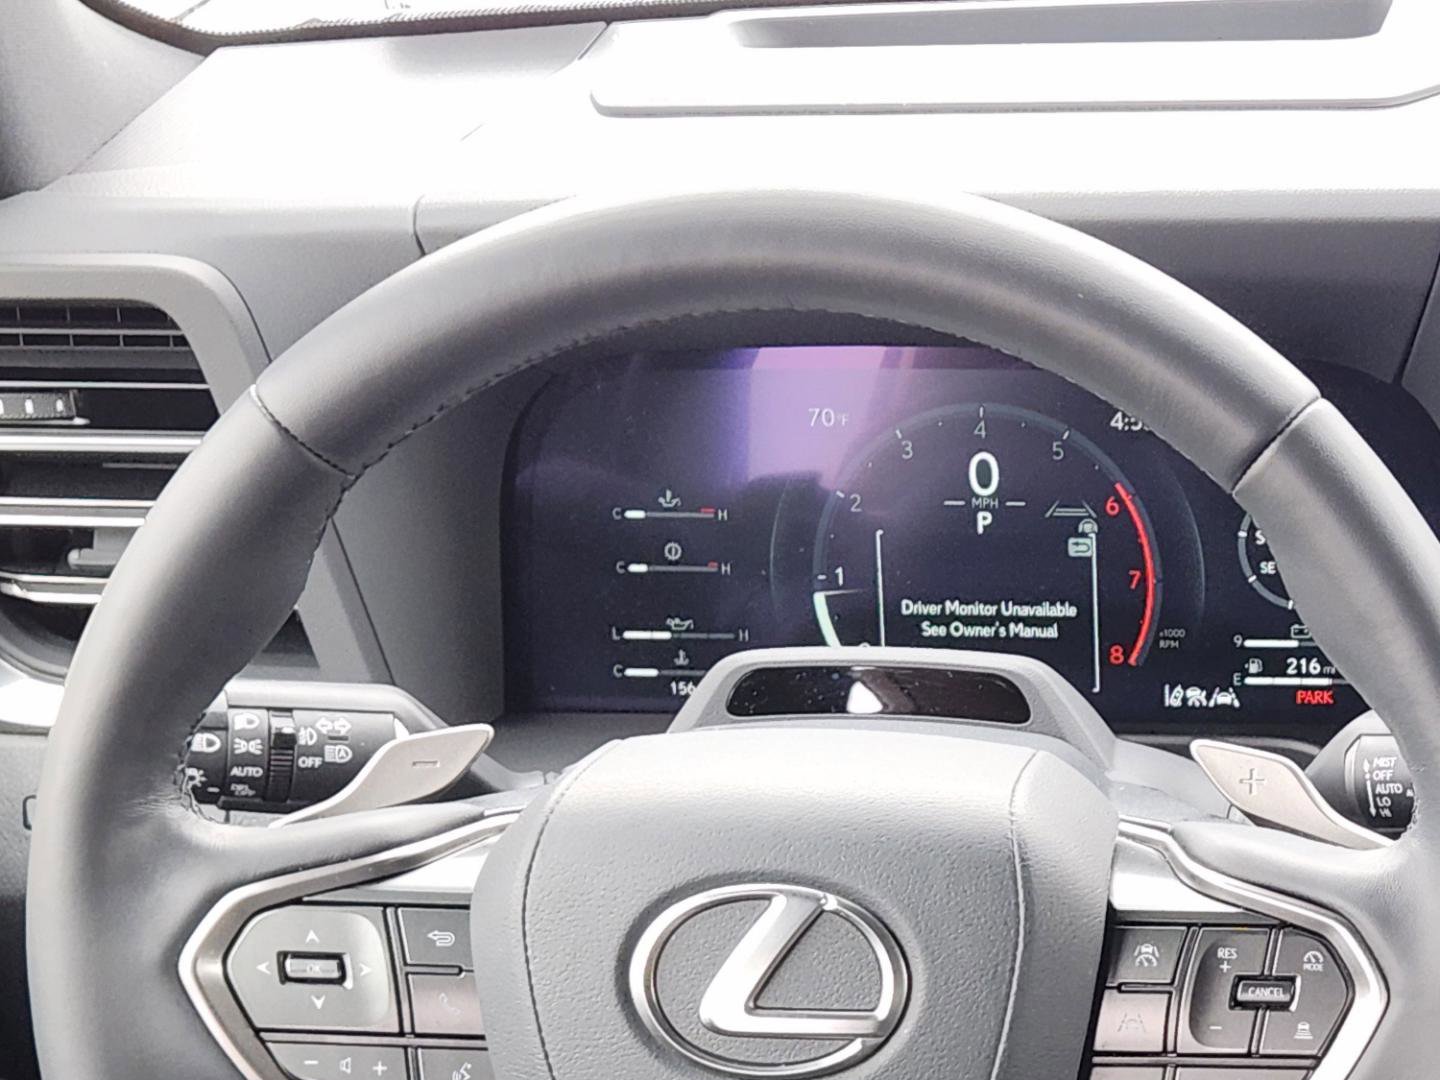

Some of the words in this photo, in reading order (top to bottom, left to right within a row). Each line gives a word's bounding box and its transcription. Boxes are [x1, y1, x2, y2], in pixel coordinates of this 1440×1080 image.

[1109, 411, 1148, 431] 4:5
[974, 423, 986, 438] 4
[901, 441, 914, 459] 3
[1052, 442, 1064, 460] 5
[968, 451, 1000, 496] 0
[850, 495, 861, 512] 2
[972, 498, 998, 509] MPH
[1105, 496, 1119, 515] 6
[977, 511, 993, 535] P
[835, 567, 844, 584] 1
[1128, 570, 1141, 589] 7
[901, 599, 942, 615] Driver
[946, 601, 997, 616] Monitor
[1001, 601, 1077, 618] Unavailable
[921, 621, 946, 636] See
[950, 621, 1006, 637] Owner's
[1010, 622, 1058, 638] Manual
[1233, 636, 1241, 648] 9
[1109, 646, 1124, 664] 8
[1286, 658, 1321, 674] 216
[1233, 674, 1241, 685] E
[1296, 690, 1333, 704] PARK
[298, 756, 322, 768] OFF
[1372, 756, 1397, 768] MIST
[230, 766, 263, 778] AUTO
[1372, 769, 1394, 781] OFF
[1375, 782, 1403, 794] AUTO
[1376, 796, 1391, 807] LO
[1217, 947, 1237, 959] RES
[1303, 963, 1324, 972] MODE
[1248, 987, 1285, 998] CANCEL
